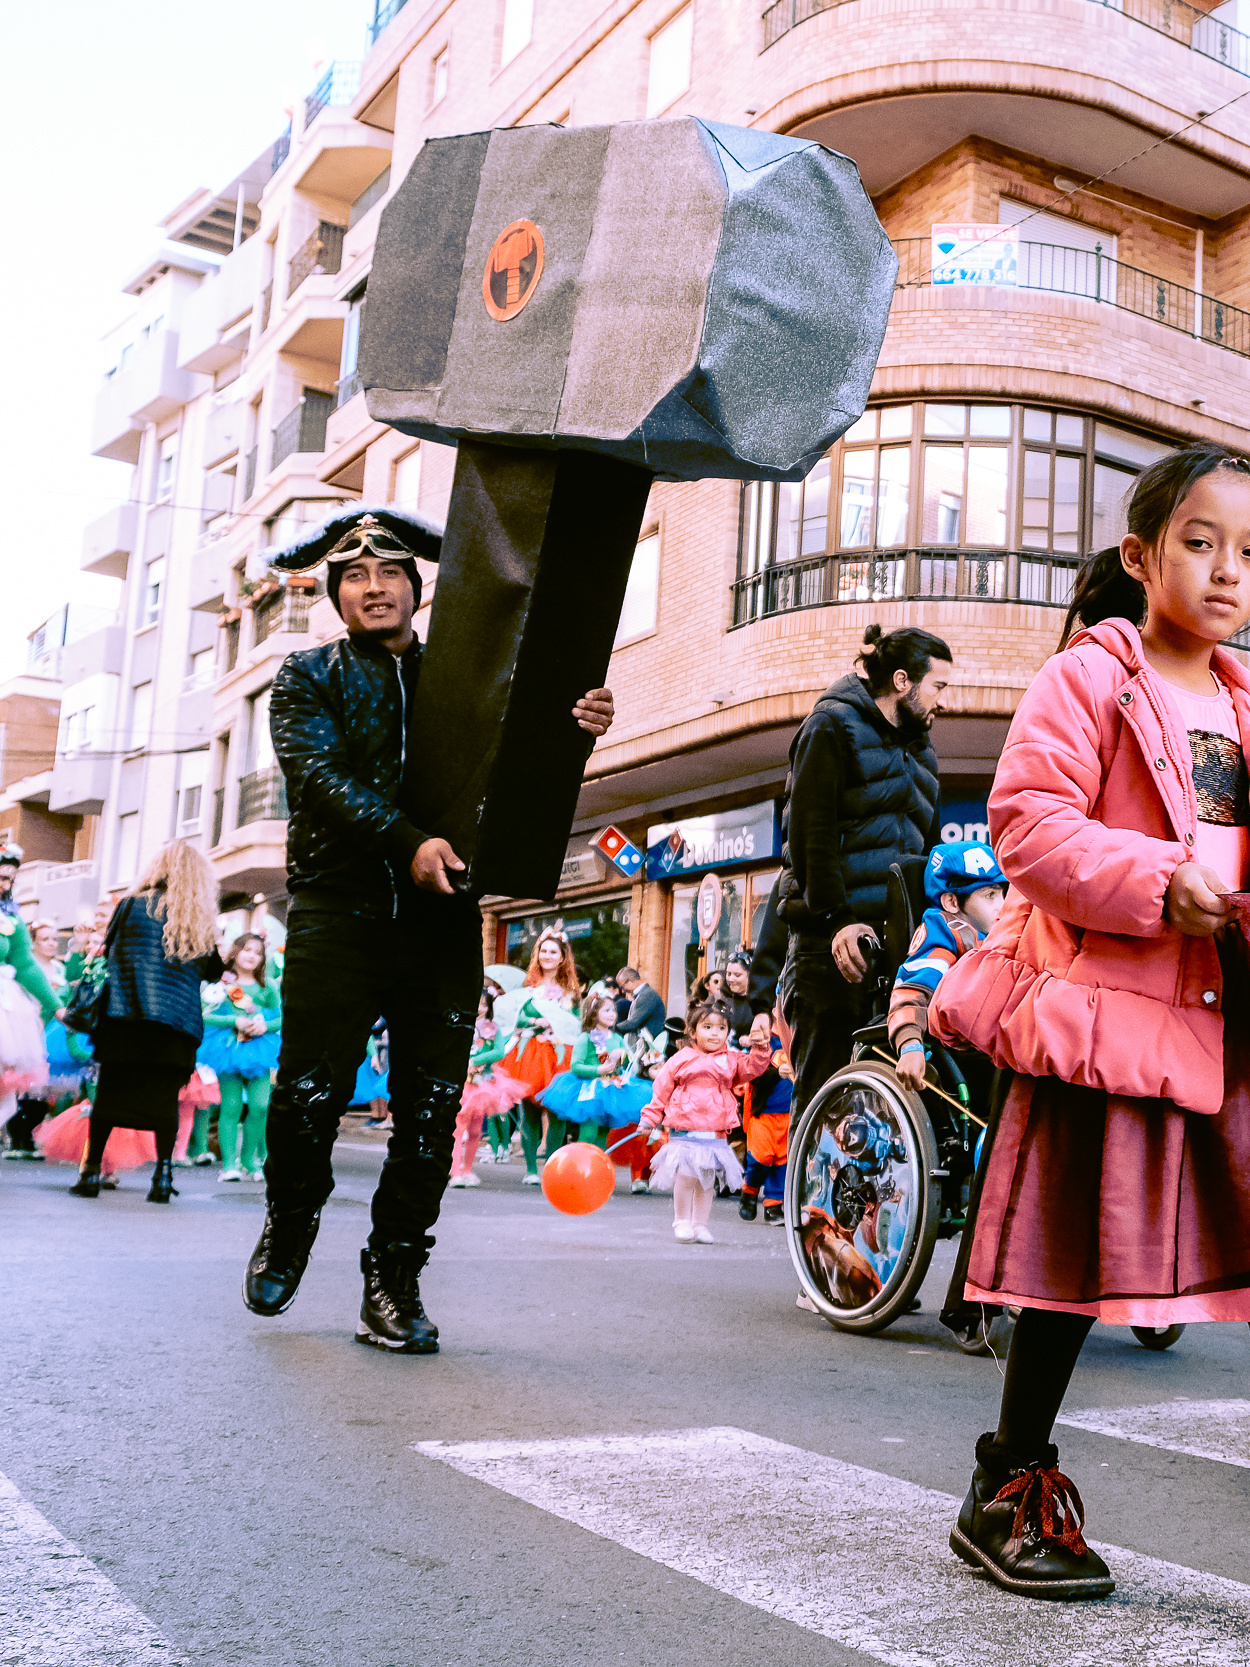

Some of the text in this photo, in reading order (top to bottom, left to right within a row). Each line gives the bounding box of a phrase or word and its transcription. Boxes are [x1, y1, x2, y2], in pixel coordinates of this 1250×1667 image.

[958, 229, 973, 239] SE
[976, 229, 1017, 241] VENDE
[933, 268, 1017, 282] 664 778 316
[682, 826, 754, 869] Domino's
[963, 847, 995, 875] A
